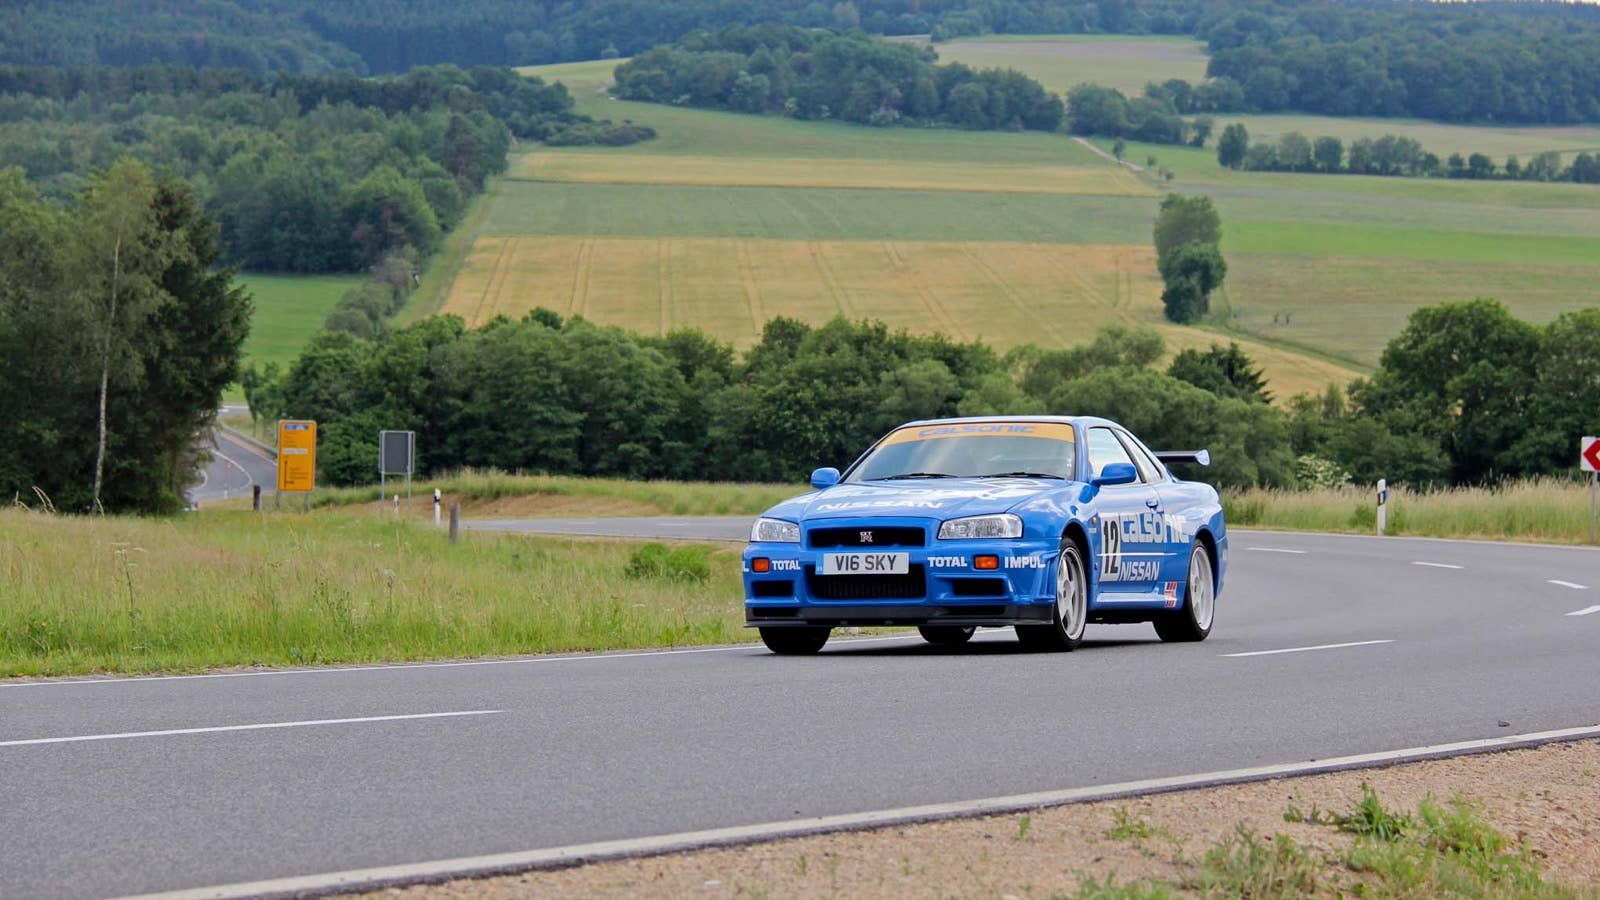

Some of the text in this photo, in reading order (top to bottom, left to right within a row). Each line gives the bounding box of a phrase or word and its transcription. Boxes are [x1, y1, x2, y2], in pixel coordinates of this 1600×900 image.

[816, 501, 943, 512] NISSAN
[1103, 520, 1119, 574] 12
[771, 560, 801, 571] TOTAL
[835, 555, 897, 571] V16 SKY
[927, 556, 968, 568] TOTAL
[1004, 556, 1047, 569] IMPUL
[1120, 561, 1160, 581] NISSAN
